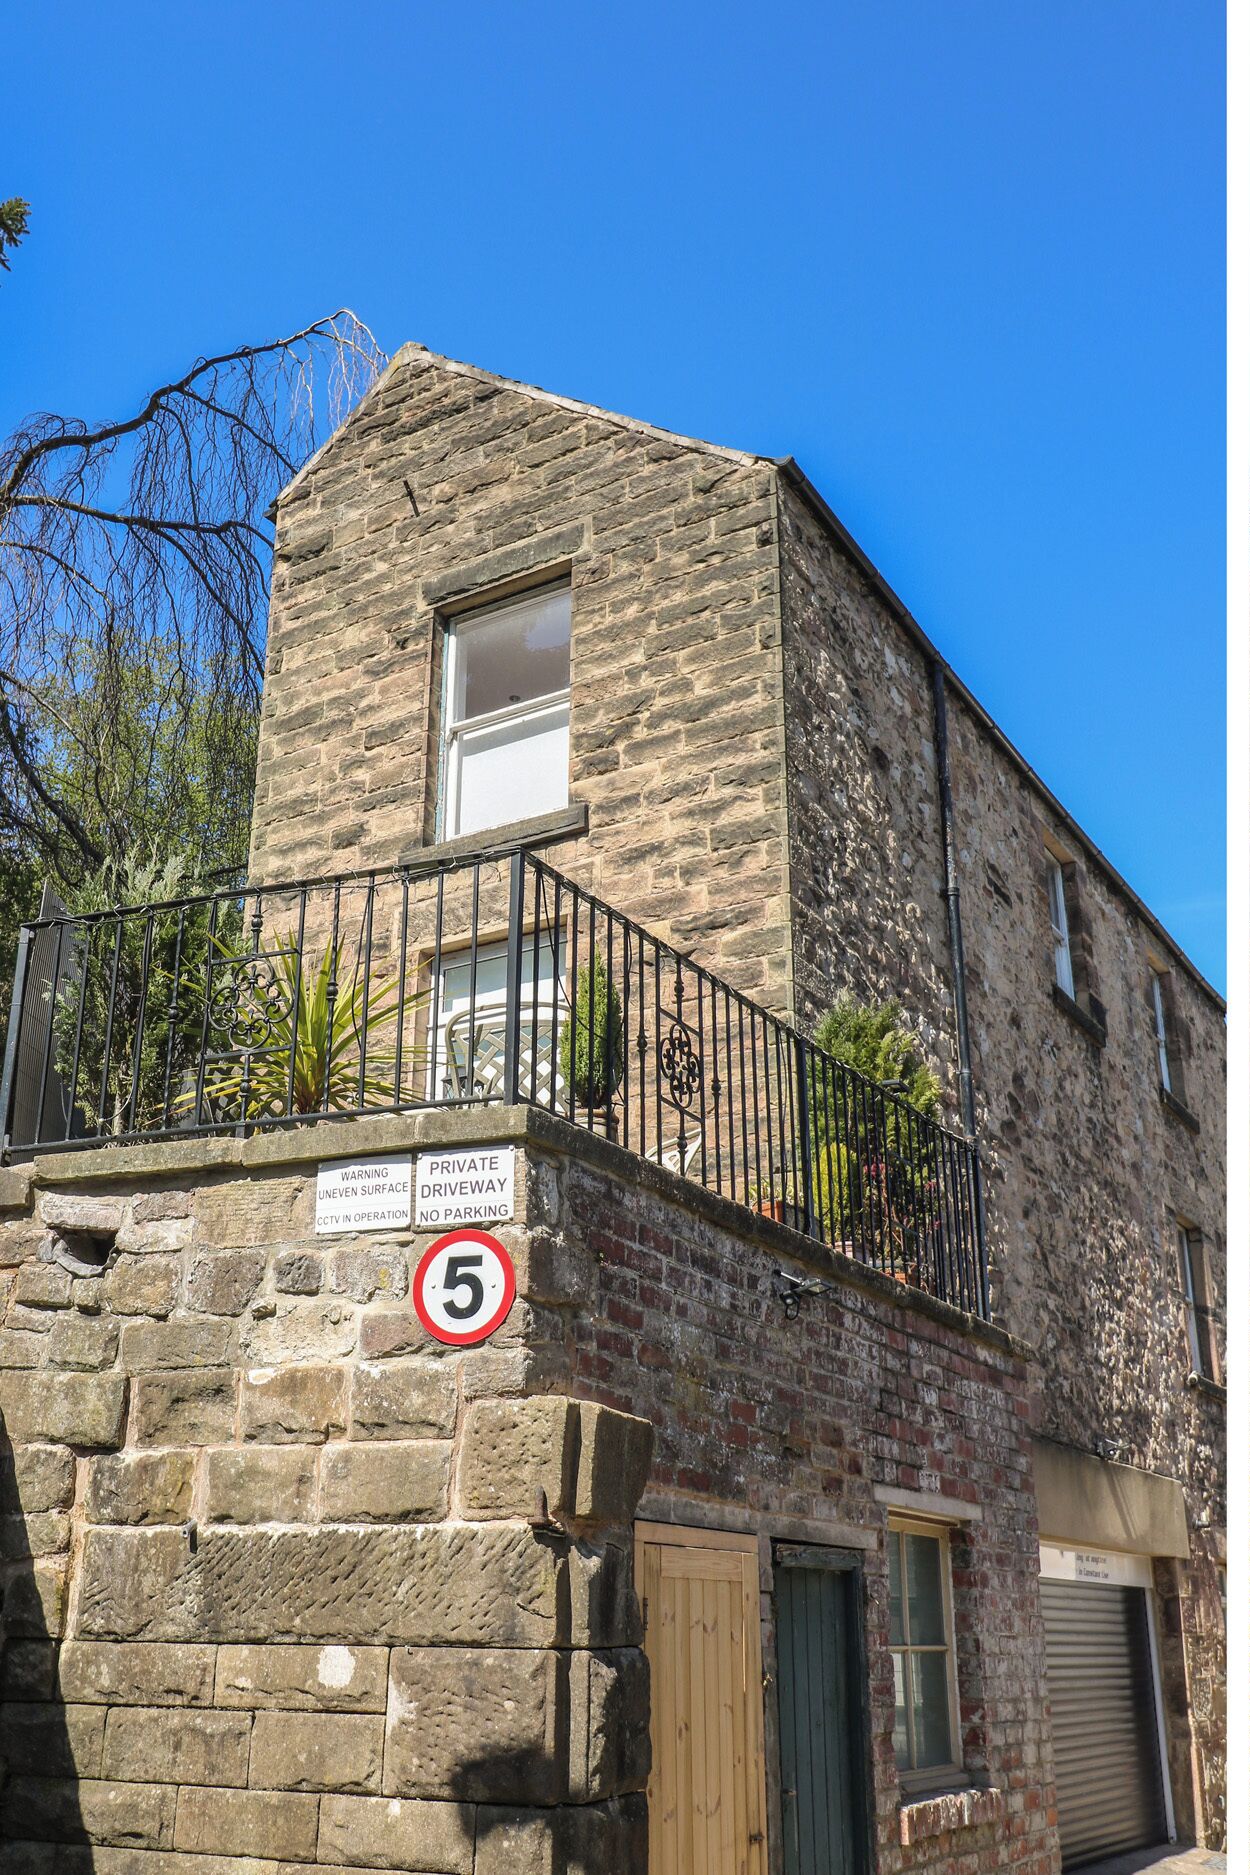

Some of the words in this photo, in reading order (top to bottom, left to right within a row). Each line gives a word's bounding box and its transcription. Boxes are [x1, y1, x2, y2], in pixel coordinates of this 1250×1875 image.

[341, 1167, 389, 1181] WARNING
[430, 1156, 499, 1175] PRIVATE
[318, 1186, 357, 1200] UNEVEN
[361, 1182, 409, 1196] SURFACE
[421, 1178, 507, 1198] DRIVEWAY
[317, 1212, 340, 1226] CCTV
[342, 1214, 351, 1223] IN
[354, 1209, 409, 1222] OPERATION
[420, 1209, 440, 1223] NO
[444, 1204, 509, 1220] PARKING
[442, 1254, 484, 1320] 5
